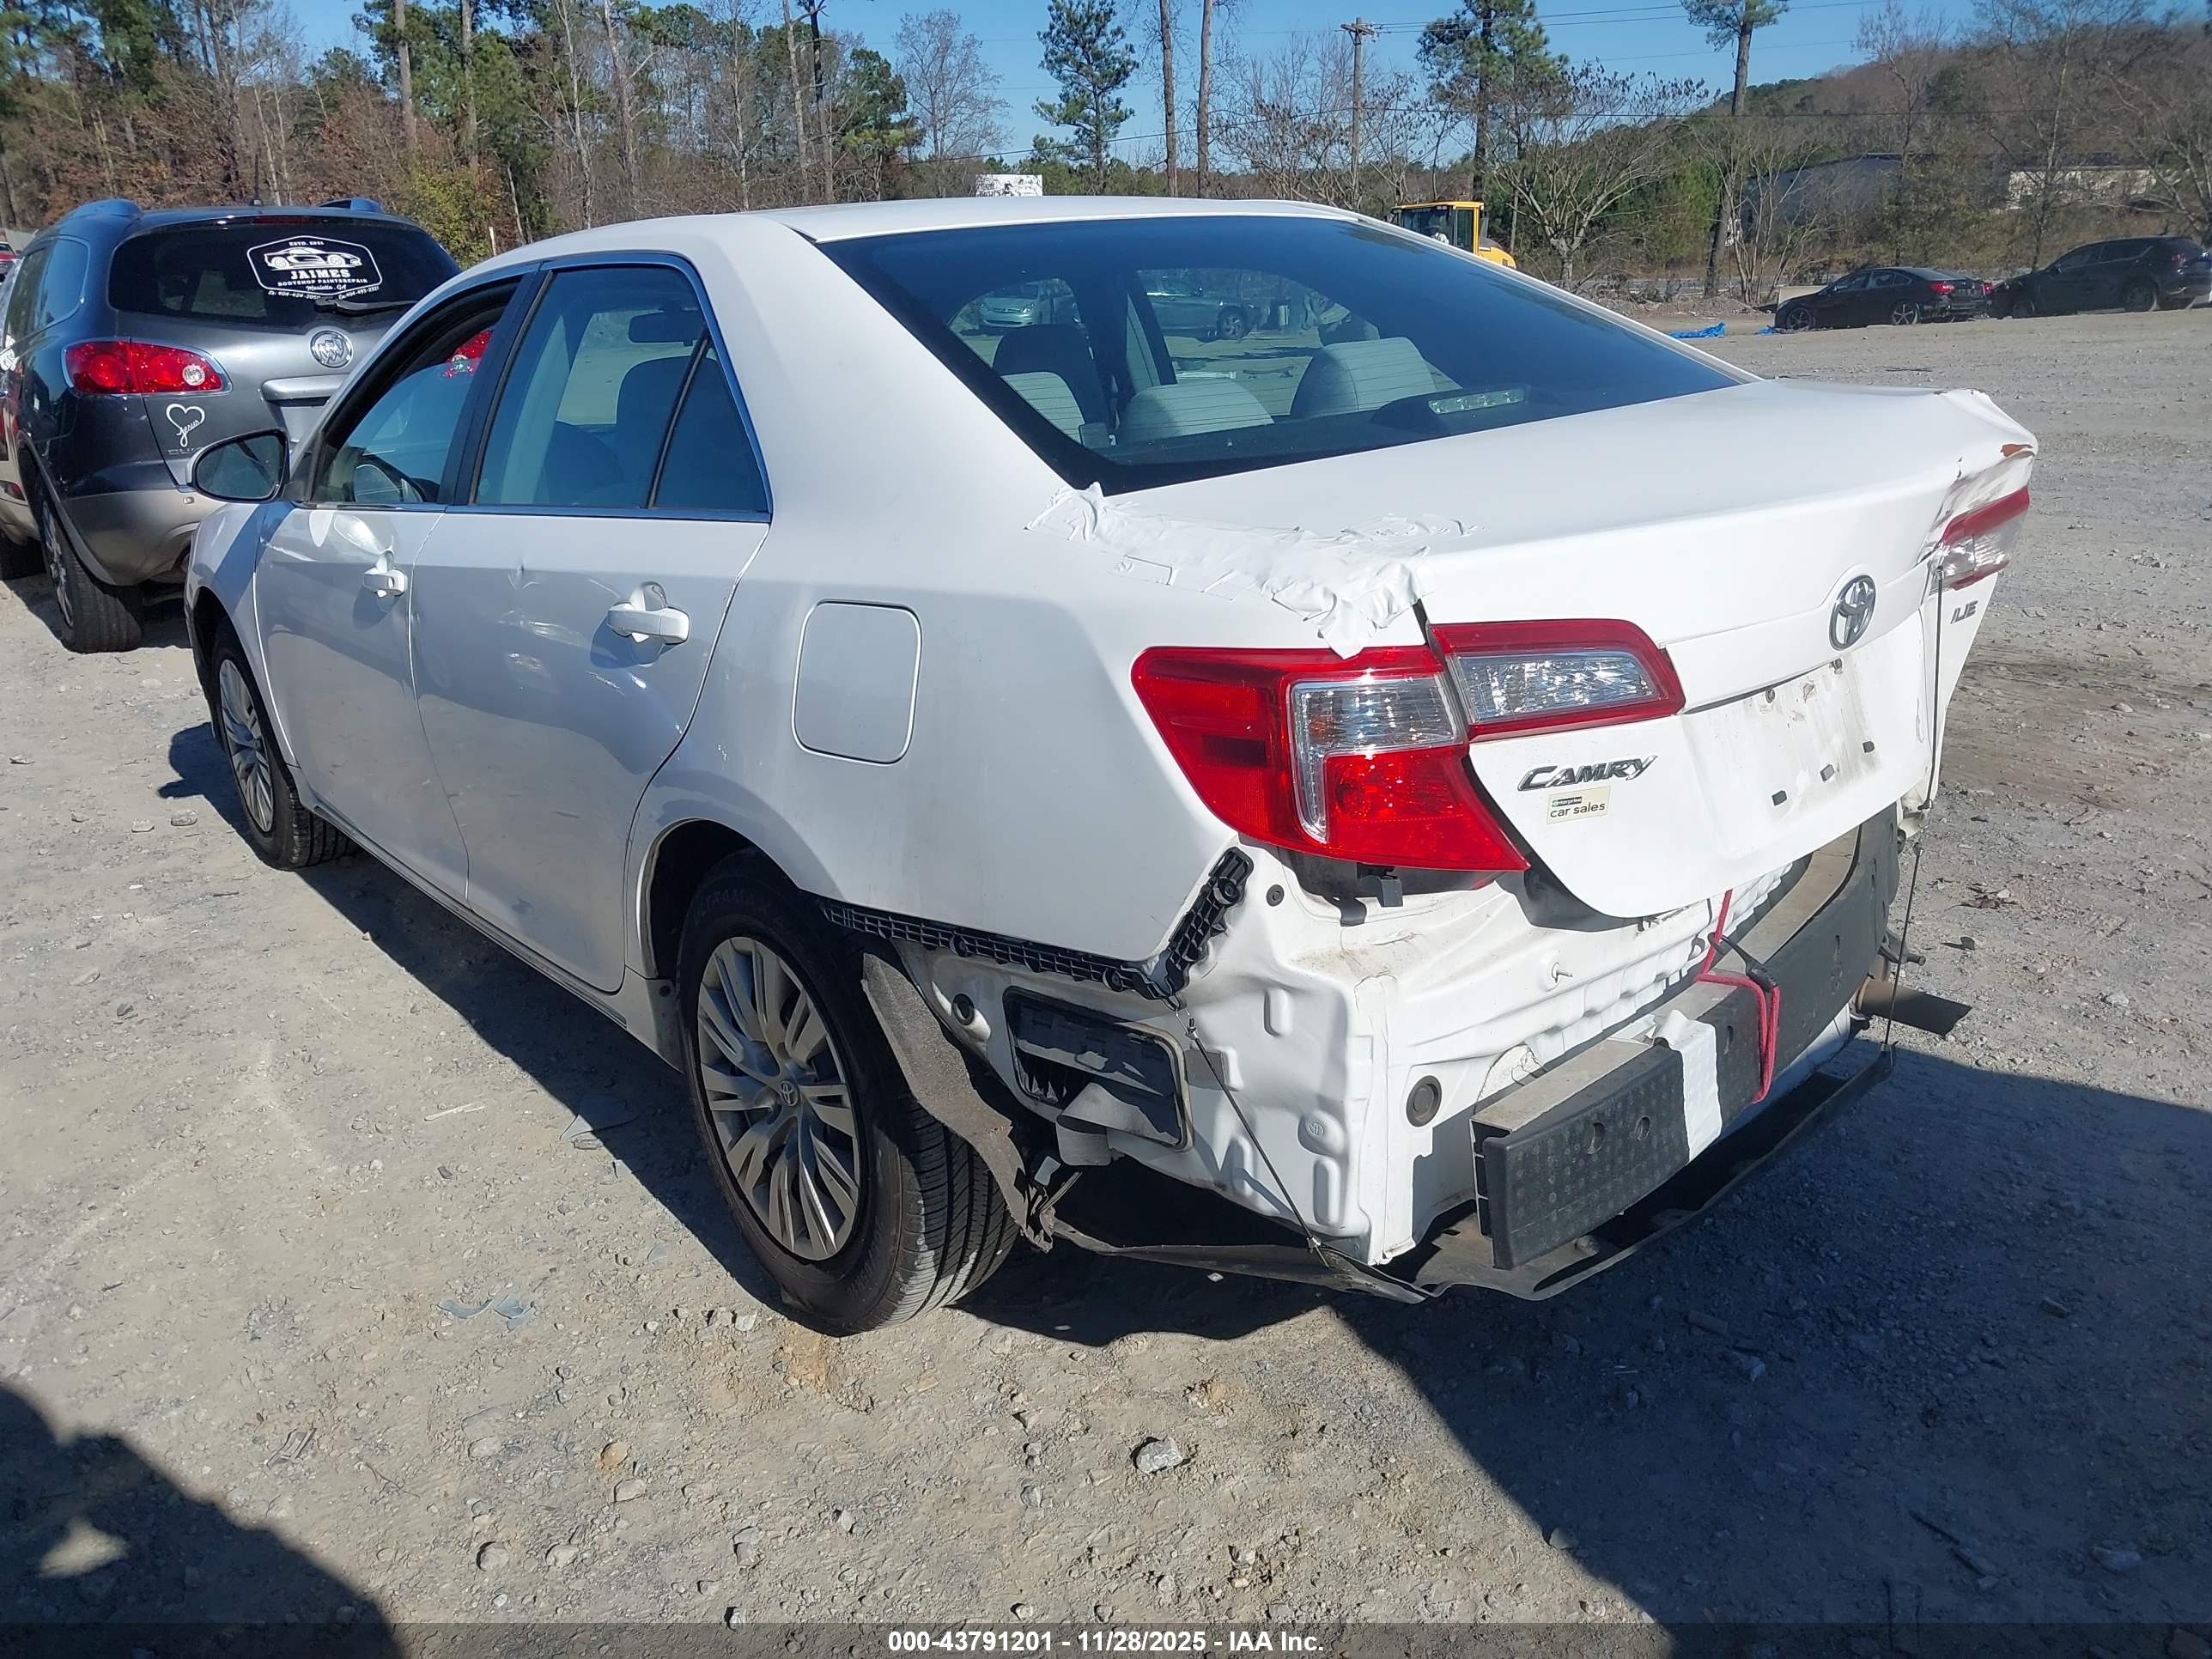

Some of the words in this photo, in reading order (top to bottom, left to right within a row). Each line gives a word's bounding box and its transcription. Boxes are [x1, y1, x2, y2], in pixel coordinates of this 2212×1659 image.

[291, 270, 351, 279] JAIMES
[176, 419, 201, 440] Jesus
[1950, 600, 1978, 624] LE
[1517, 755, 1658, 791] CAMRY
[1550, 808, 1571, 817] car
[1573, 801, 1606, 814] sales
